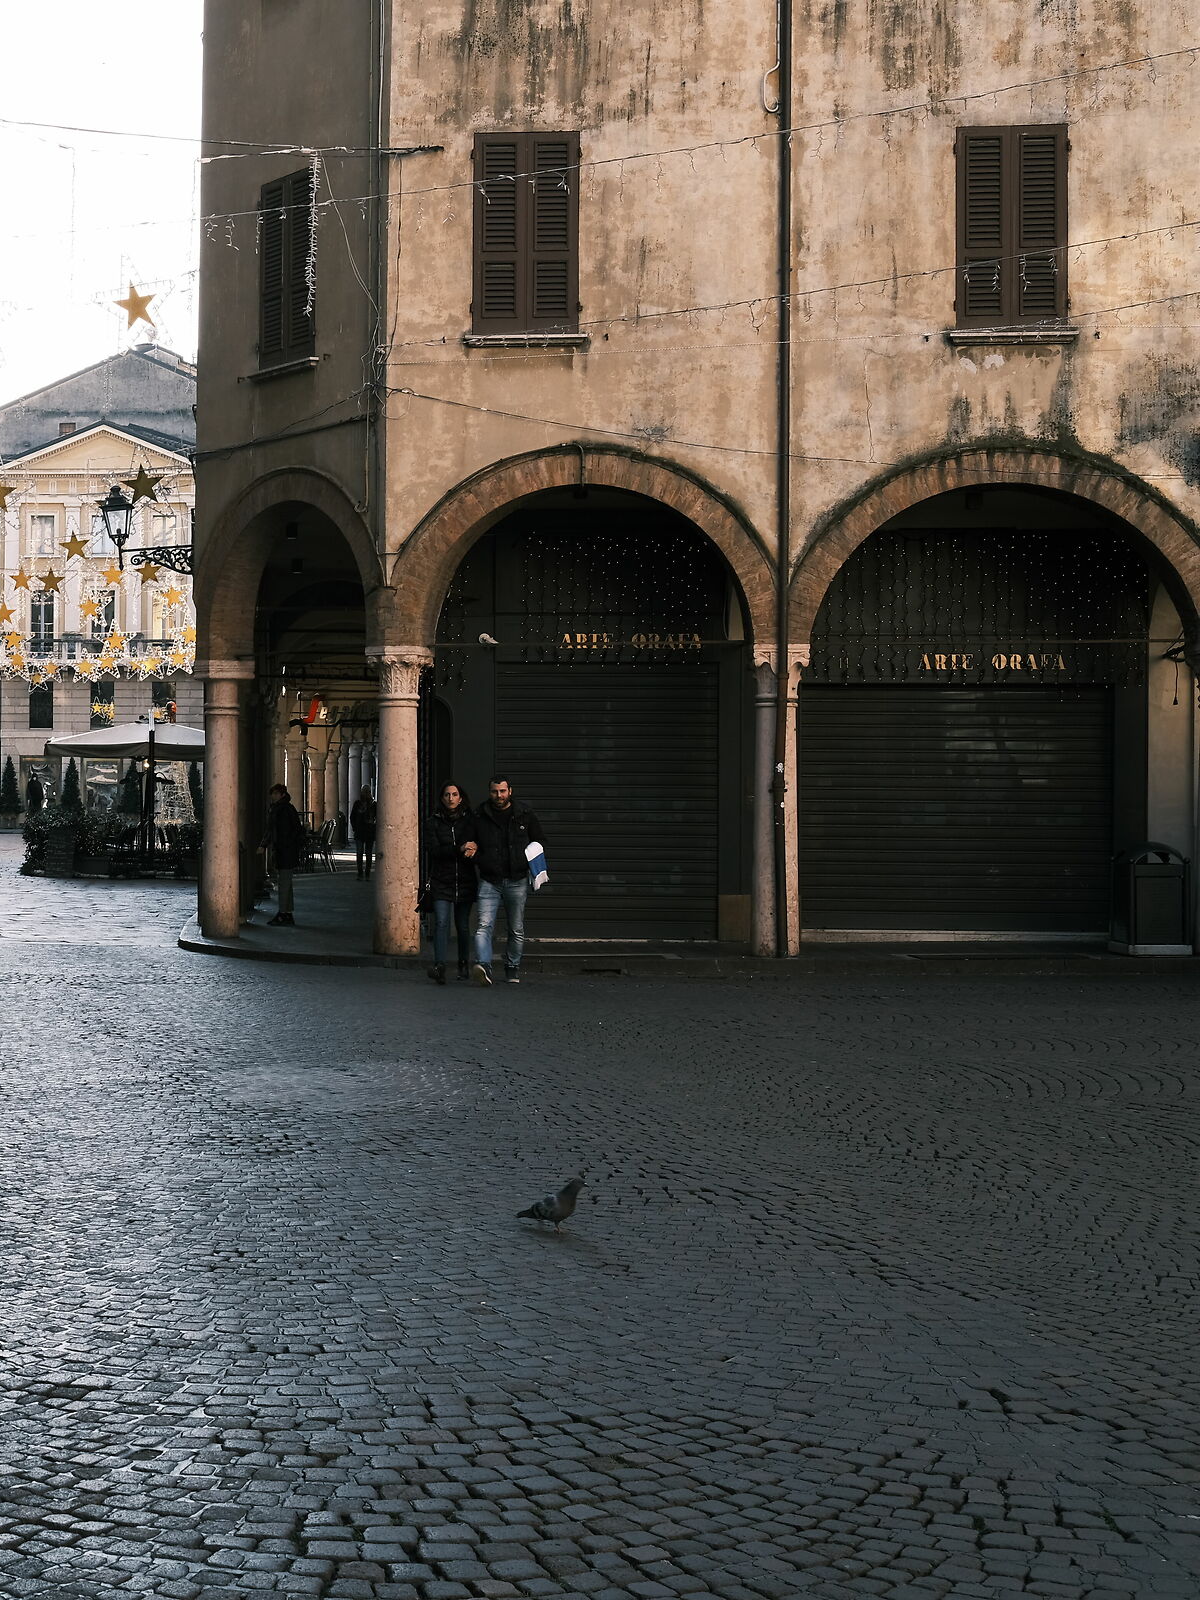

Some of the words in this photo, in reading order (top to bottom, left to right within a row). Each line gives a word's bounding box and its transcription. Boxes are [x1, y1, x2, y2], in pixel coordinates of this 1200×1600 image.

[557, 632, 614, 649] ARTE
[917, 653, 974, 670] ARTE
[991, 653, 1067, 670] ORAFA
